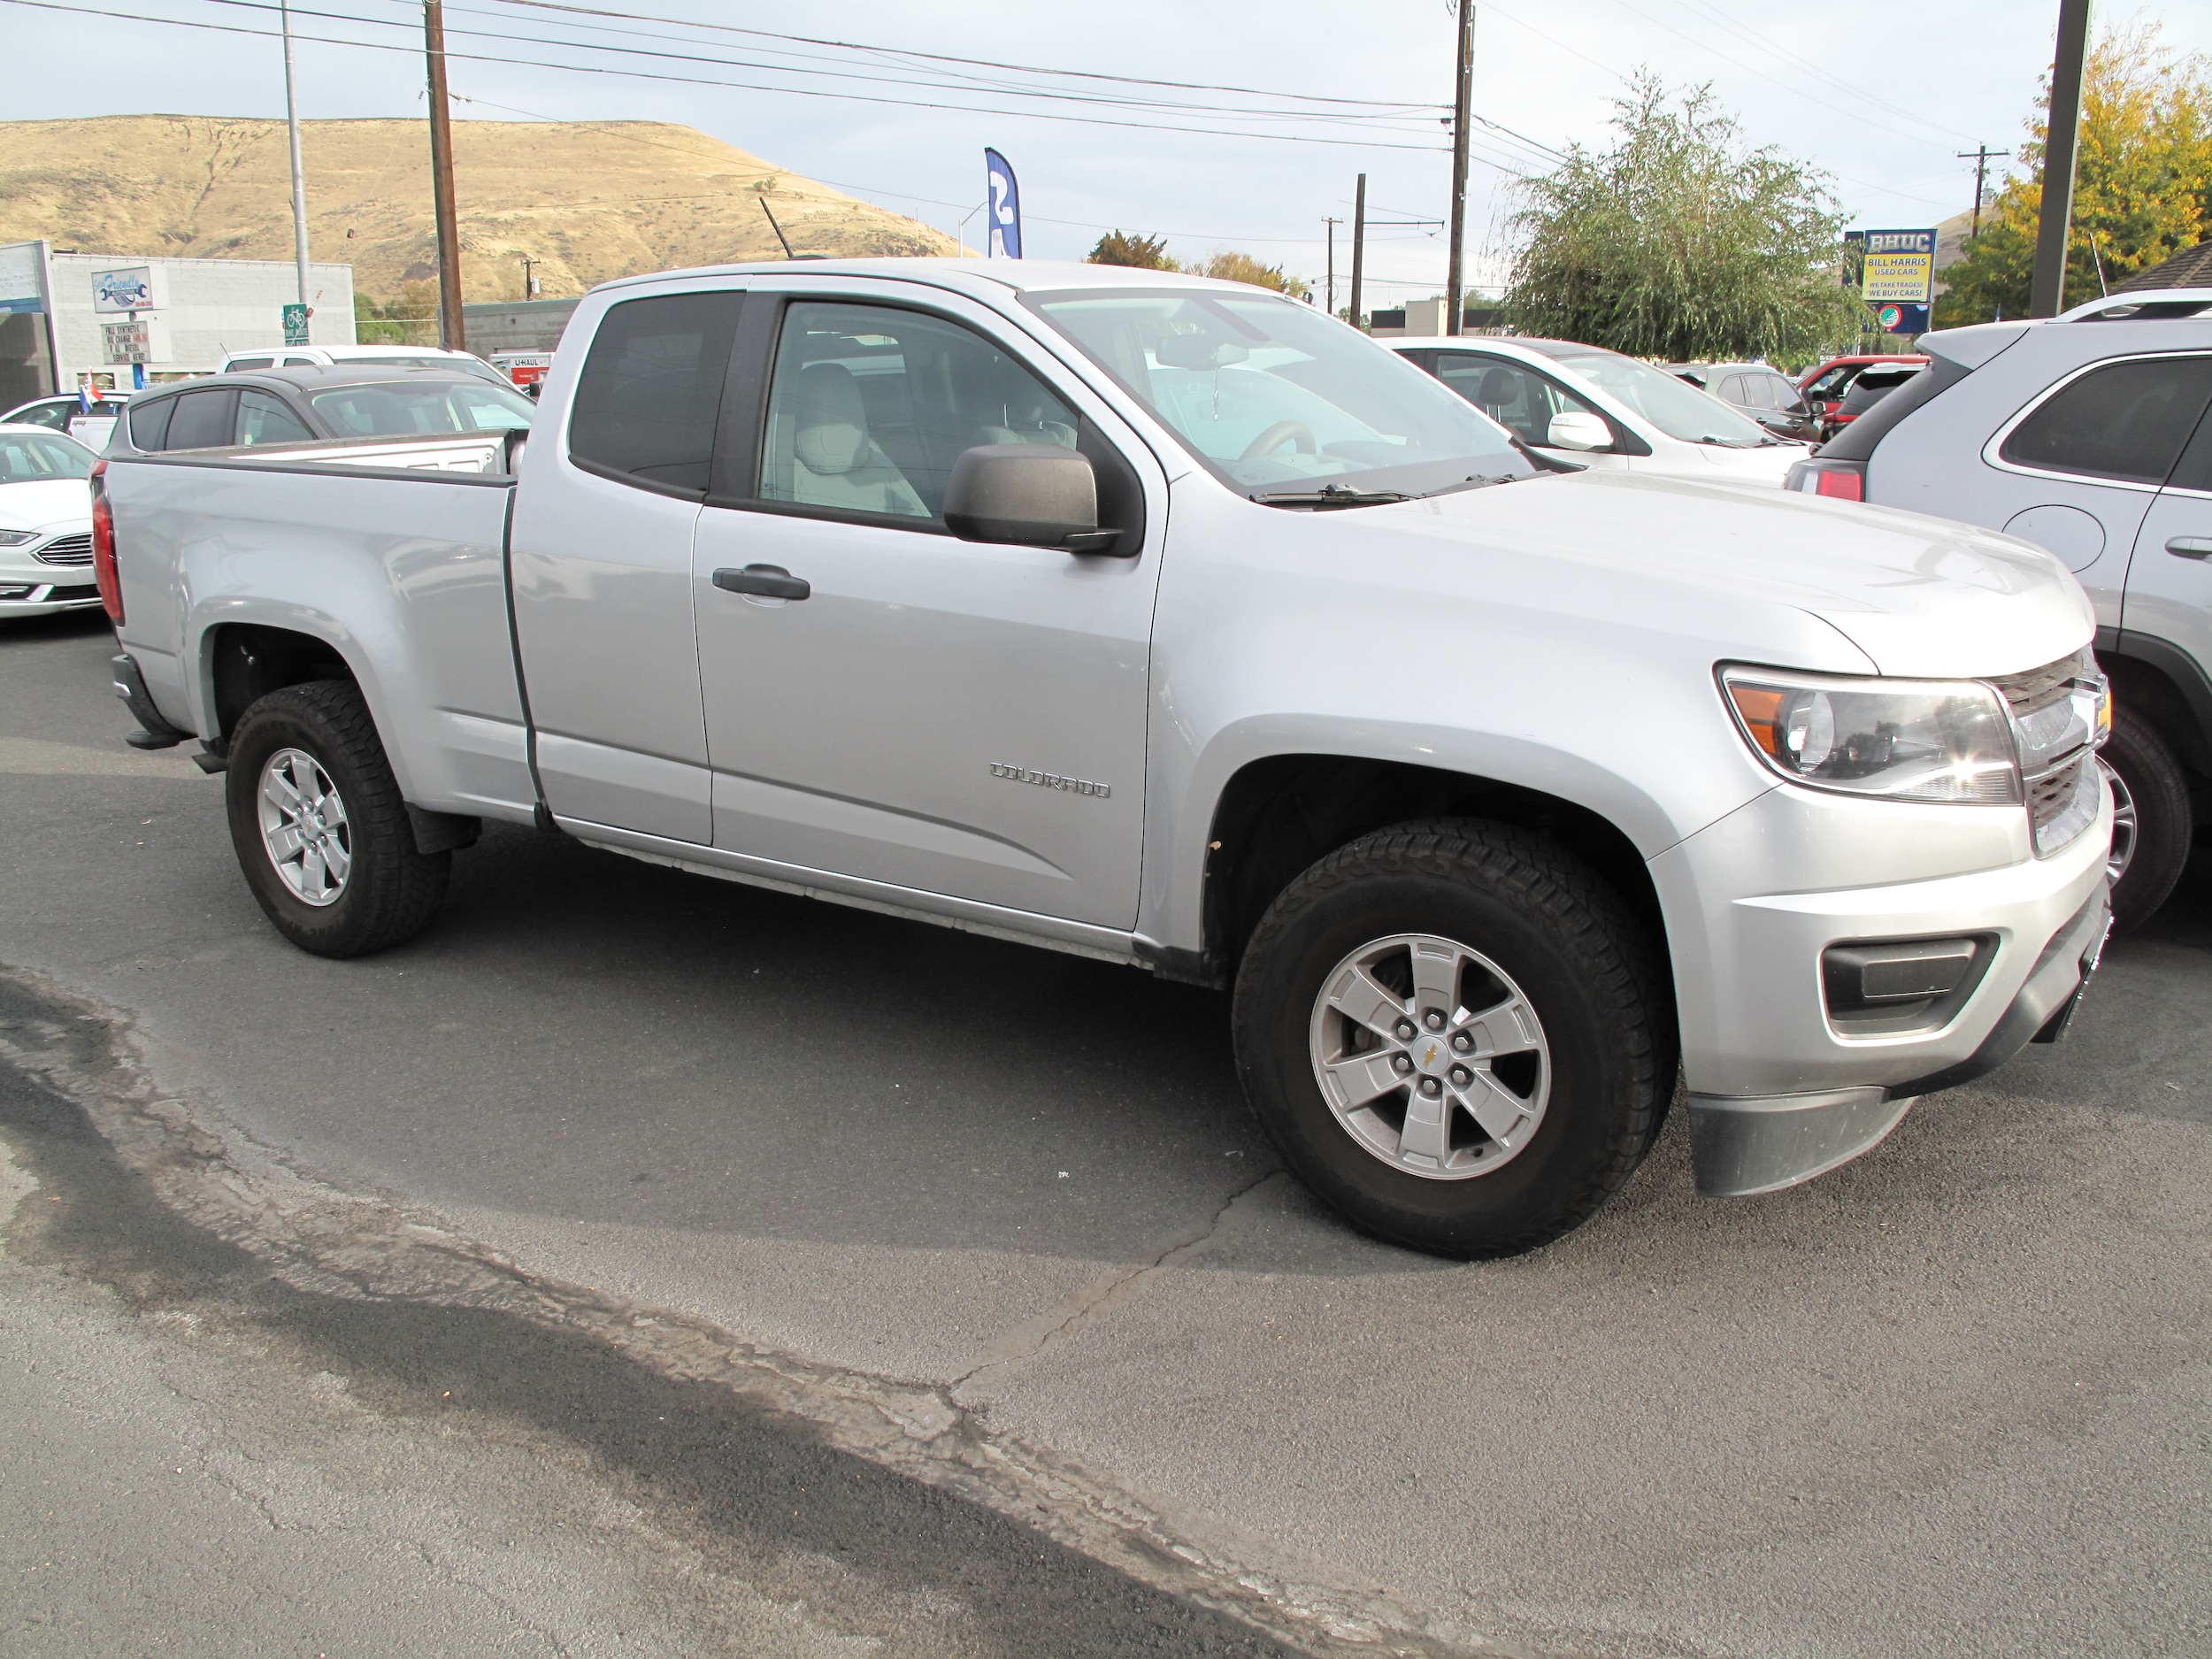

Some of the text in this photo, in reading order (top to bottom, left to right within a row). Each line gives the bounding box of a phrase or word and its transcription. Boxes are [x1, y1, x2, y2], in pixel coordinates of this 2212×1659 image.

[1868, 233, 1931, 253] BHUC
[1890, 257, 1926, 266] HARRIS
[104, 273, 140, 290] Friendly
[117, 325, 140, 334] SYNTHETIC
[115, 334, 131, 343] CHANGE
[125, 343, 140, 352] DIESEL
[112, 353, 130, 362] SERVICE
[990, 762, 1110, 798] COLORADO
